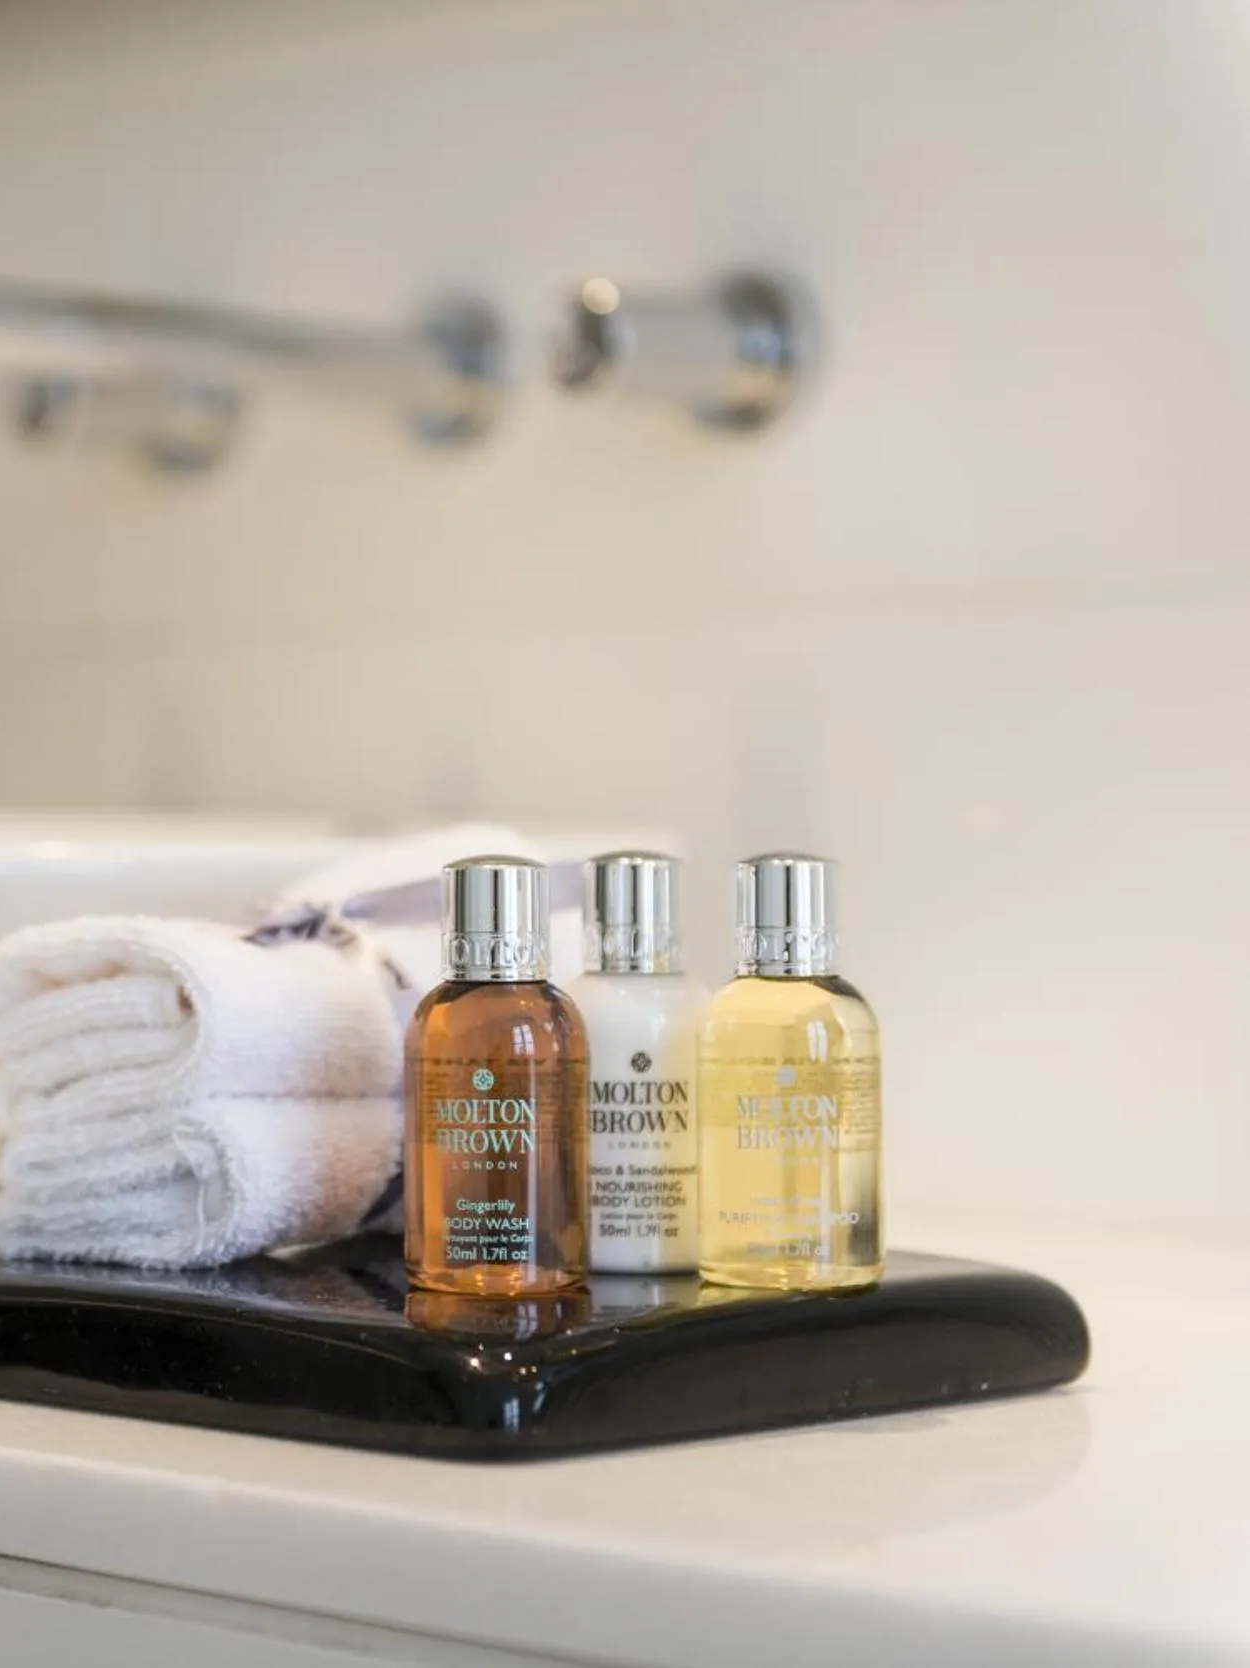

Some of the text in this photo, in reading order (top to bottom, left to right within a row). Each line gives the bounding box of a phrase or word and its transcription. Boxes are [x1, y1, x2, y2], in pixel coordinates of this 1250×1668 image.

[590, 1081, 688, 1105] MOLTON
[434, 1098, 536, 1124] MOLTON
[737, 1094, 838, 1120] MOLTON
[589, 1109, 688, 1134] BROWN
[436, 1128, 536, 1154] BROWN
[737, 1124, 839, 1150] BROWN
[451, 1160, 518, 1170] LONDON
[595, 1181, 683, 1194] NOURISHING
[456, 1198, 516, 1215] Gingerlily
[589, 1195, 687, 1208] BODY LOTION
[444, 1217, 530, 1230] BODY WASH
[599, 1225, 631, 1238] 50ml
[446, 1246, 477, 1260] 50ml
[510, 1250, 529, 1260] oz
